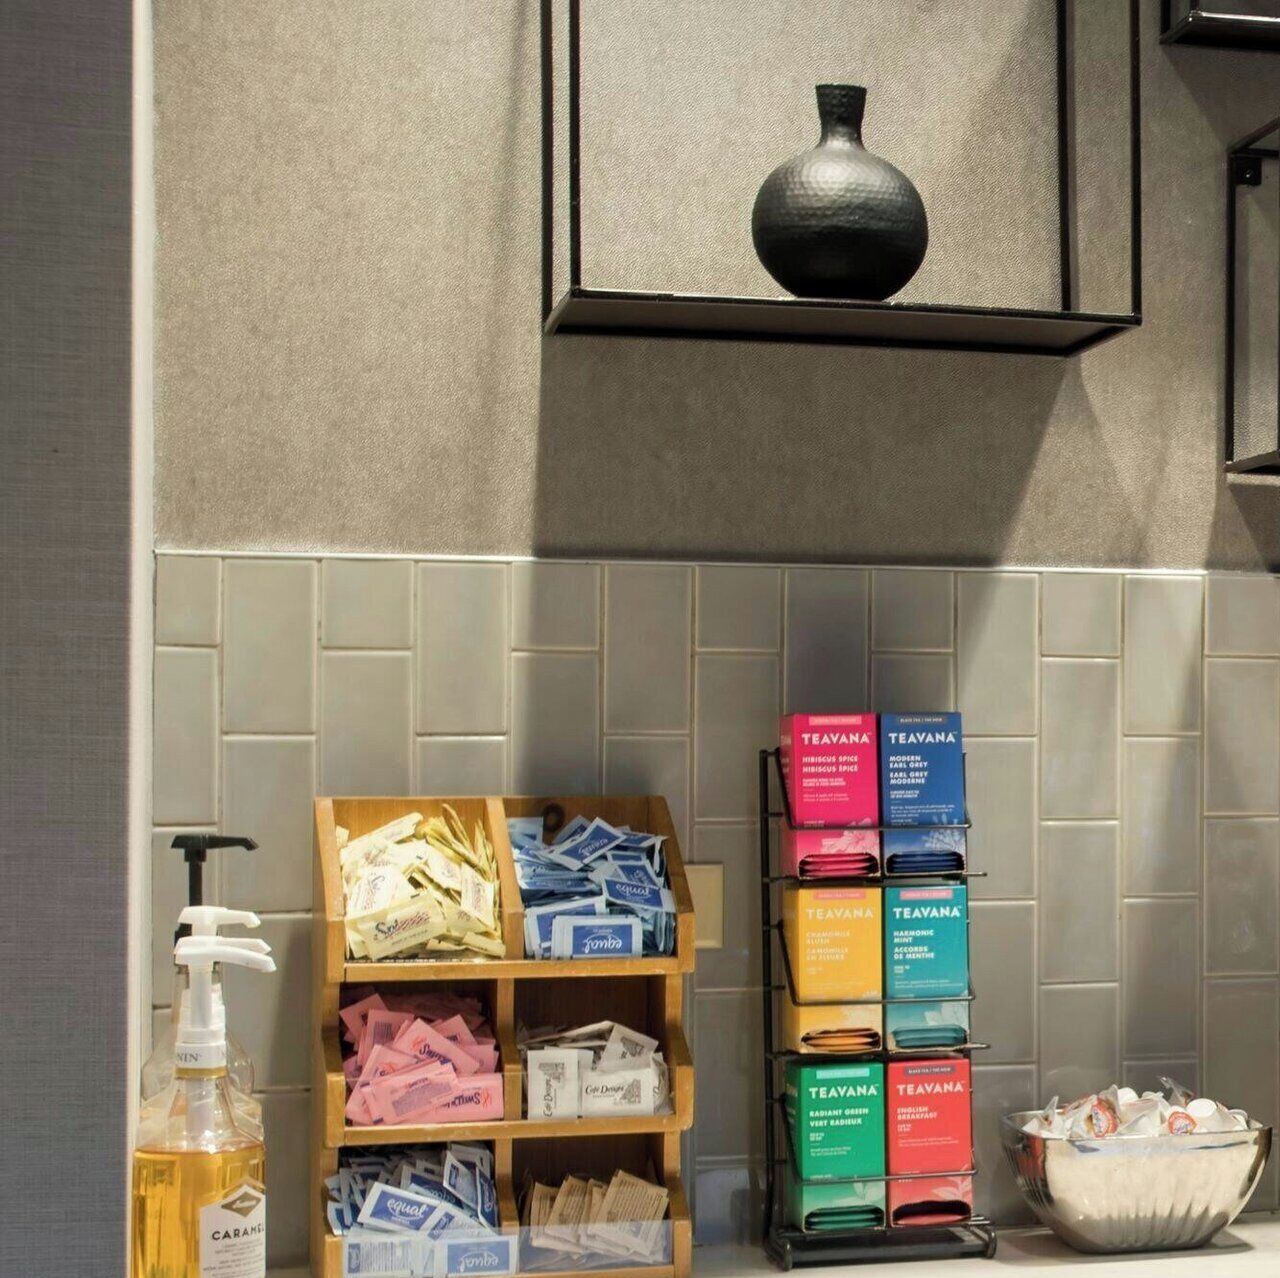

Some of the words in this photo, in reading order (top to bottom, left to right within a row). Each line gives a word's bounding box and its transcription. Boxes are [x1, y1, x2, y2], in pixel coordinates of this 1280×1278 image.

[802, 732, 870, 745] TEAVANA
[888, 731, 956, 744] TEAVANA
[805, 908, 873, 920] TEAVANA
[893, 906, 961, 919] TEAVANA
[583, 937, 623, 953] equal
[809, 1085, 878, 1099] TEAVANA
[897, 1081, 964, 1095] TEAVANA
[809, 1109, 843, 1117] RADIANT
[387, 1198, 428, 1219] equal
[458, 1253, 499, 1272] equal
